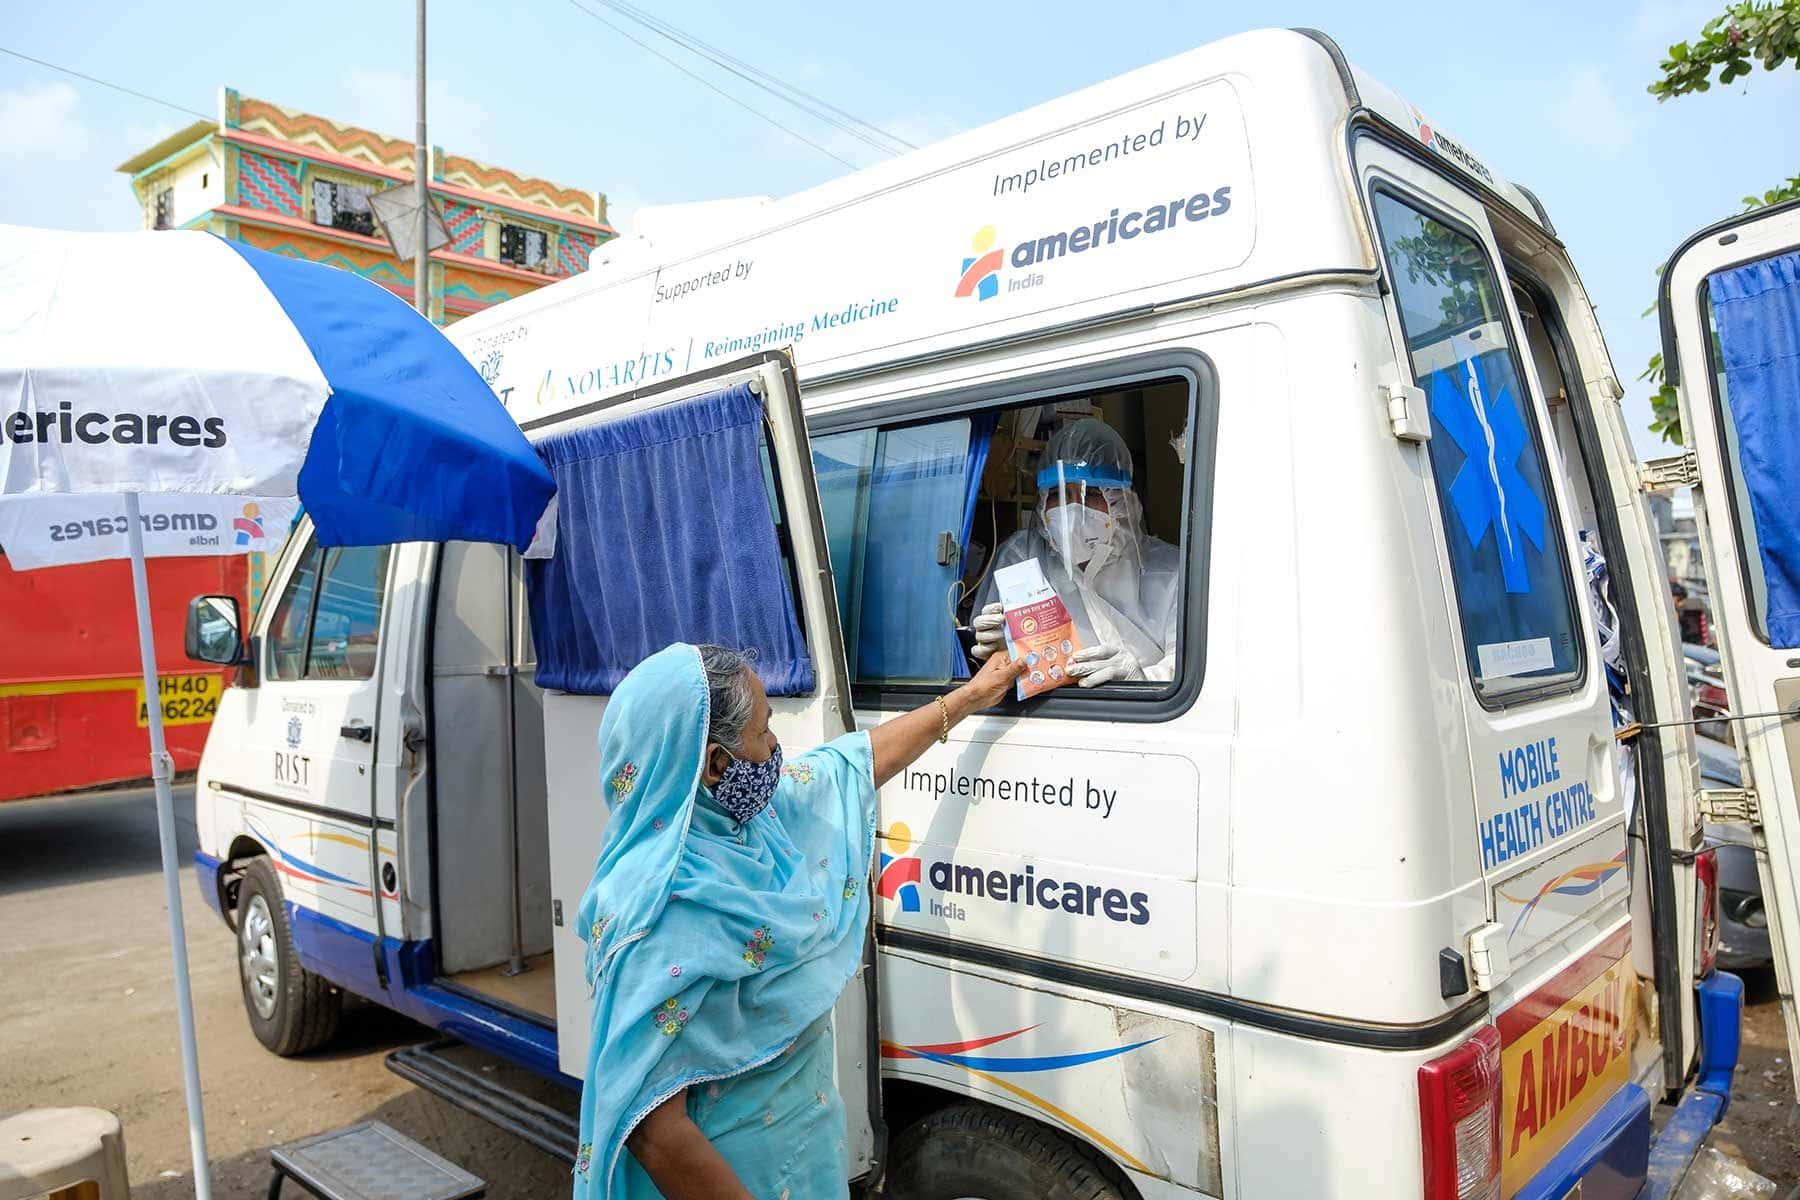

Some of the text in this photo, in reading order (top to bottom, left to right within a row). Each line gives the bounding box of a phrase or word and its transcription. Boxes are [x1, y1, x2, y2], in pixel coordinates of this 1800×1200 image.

[993, 112, 1208, 196] Implemented by
[1010, 186, 1232, 268] americares
[655, 259, 754, 303] Supported by
[1007, 272, 1045, 293] India
[704, 297, 900, 359] Reimagining Medicine
[564, 347, 676, 399] NOVARTIS
[0, 401, 227, 449] ericares
[140, 696, 217, 721] A6224
[182, 676, 209, 694] 40
[274, 752, 311, 785] RIST
[903, 767, 1117, 819] Implemented by
[1499, 737, 1561, 799] MOBILE
[1480, 780, 1596, 870] HEALTH CENTRE
[928, 860, 1150, 925] americares
[929, 898, 966, 922] India
